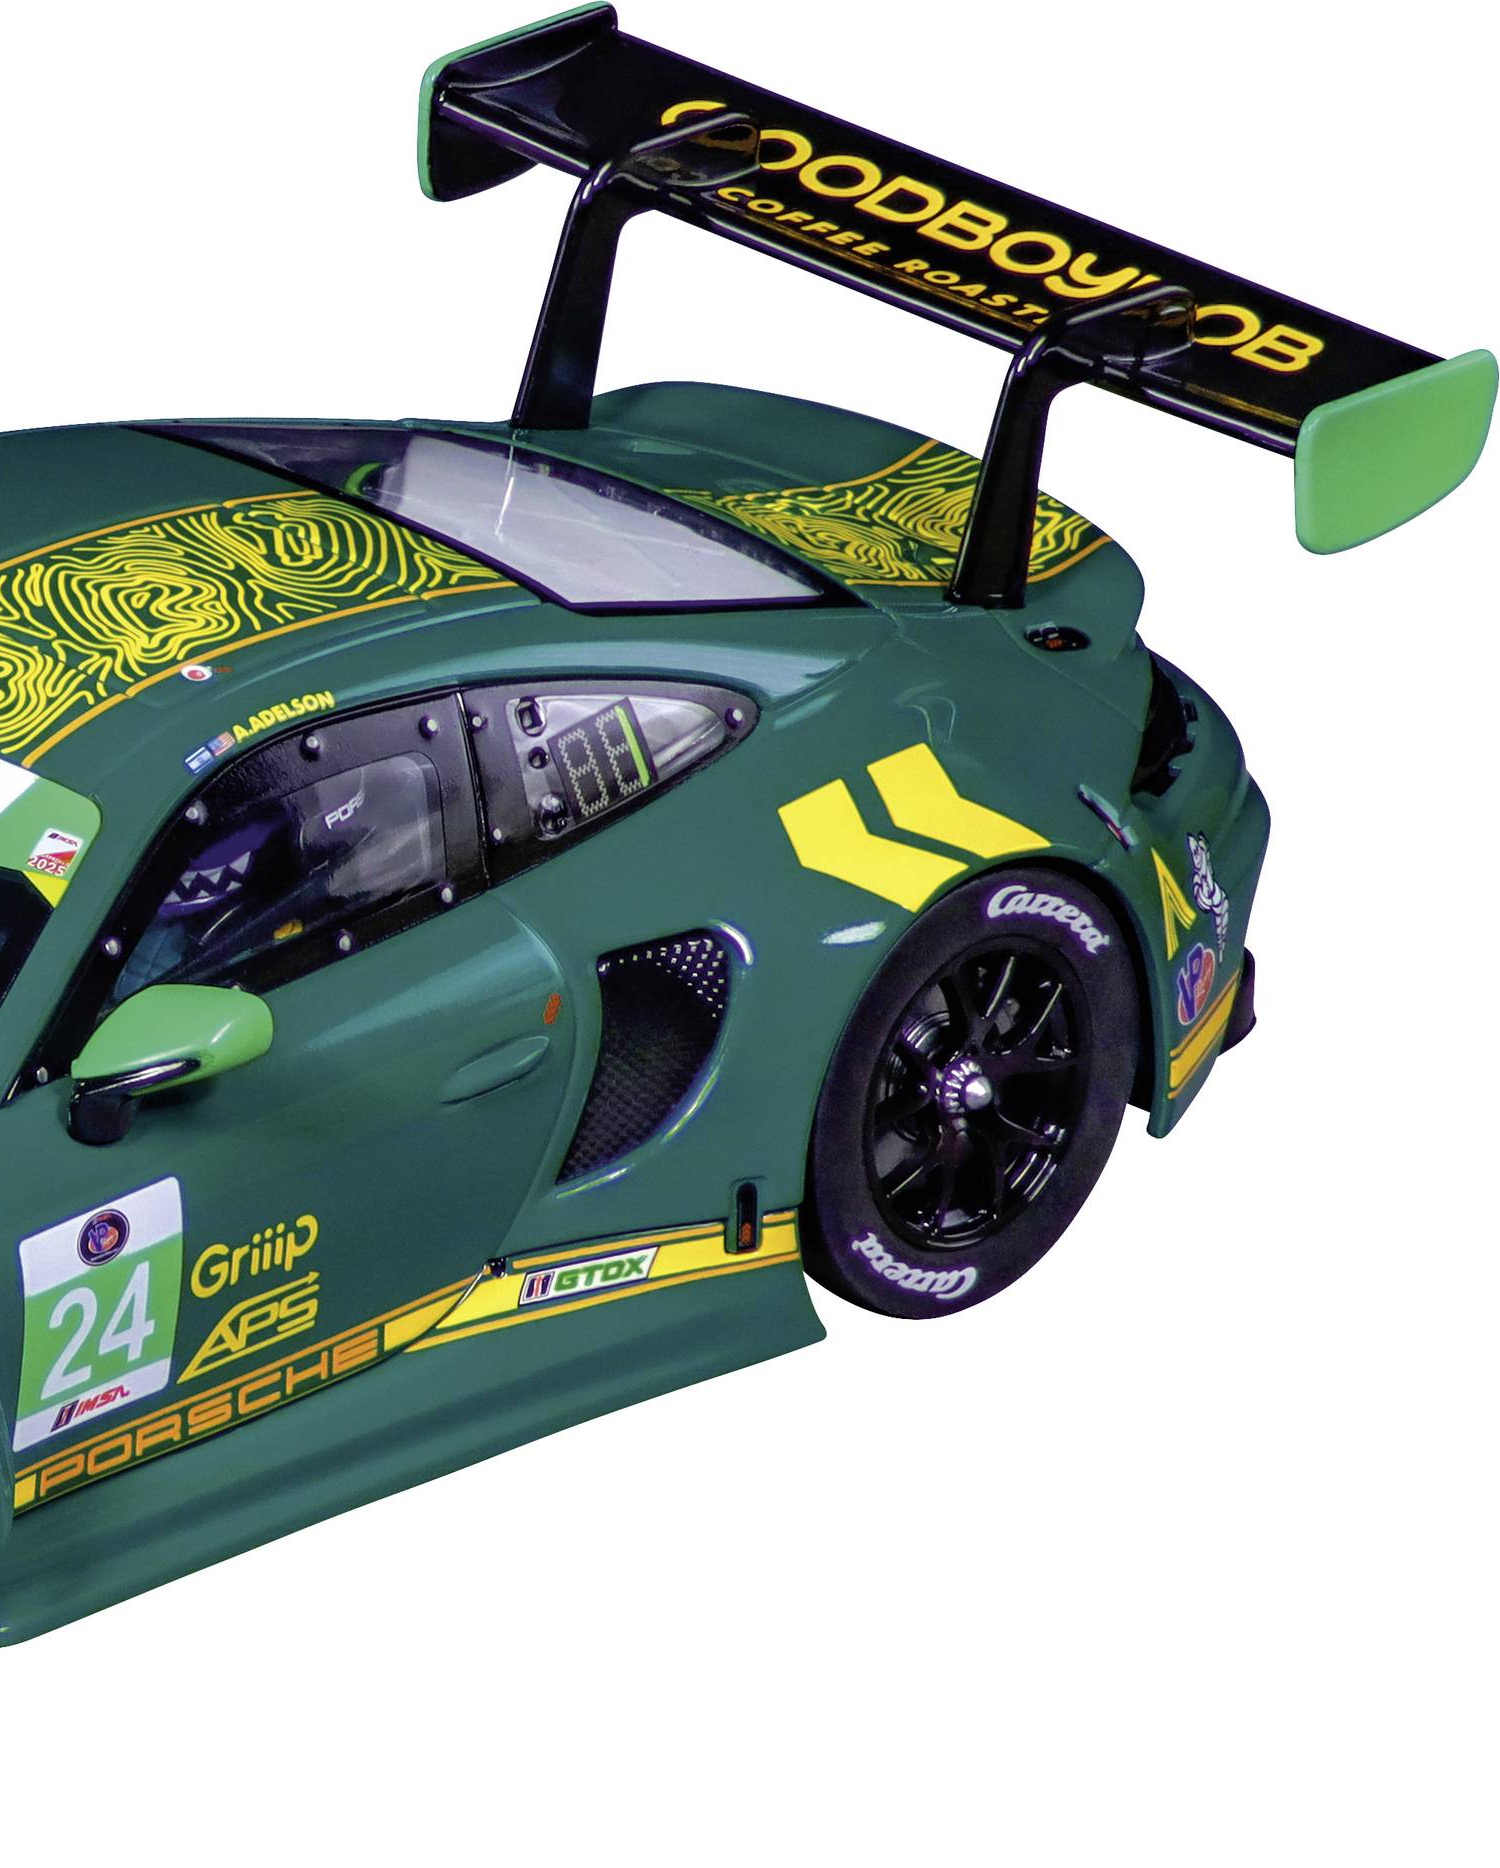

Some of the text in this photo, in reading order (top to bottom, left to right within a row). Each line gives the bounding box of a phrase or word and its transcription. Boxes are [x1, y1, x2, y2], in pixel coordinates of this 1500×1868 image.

[716, 187, 1052, 324] COFFEE ROAST
[231, 691, 336, 743] A.ADELSON
[26, 857, 66, 877] 2025
[987, 884, 1111, 954] Carrera
[191, 1214, 318, 1298] Griiip
[851, 1233, 978, 1300] Carrera
[41, 1263, 156, 1399] 24
[39, 1328, 379, 1497] PORSCHE
[74, 1384, 131, 1418] IMSA
